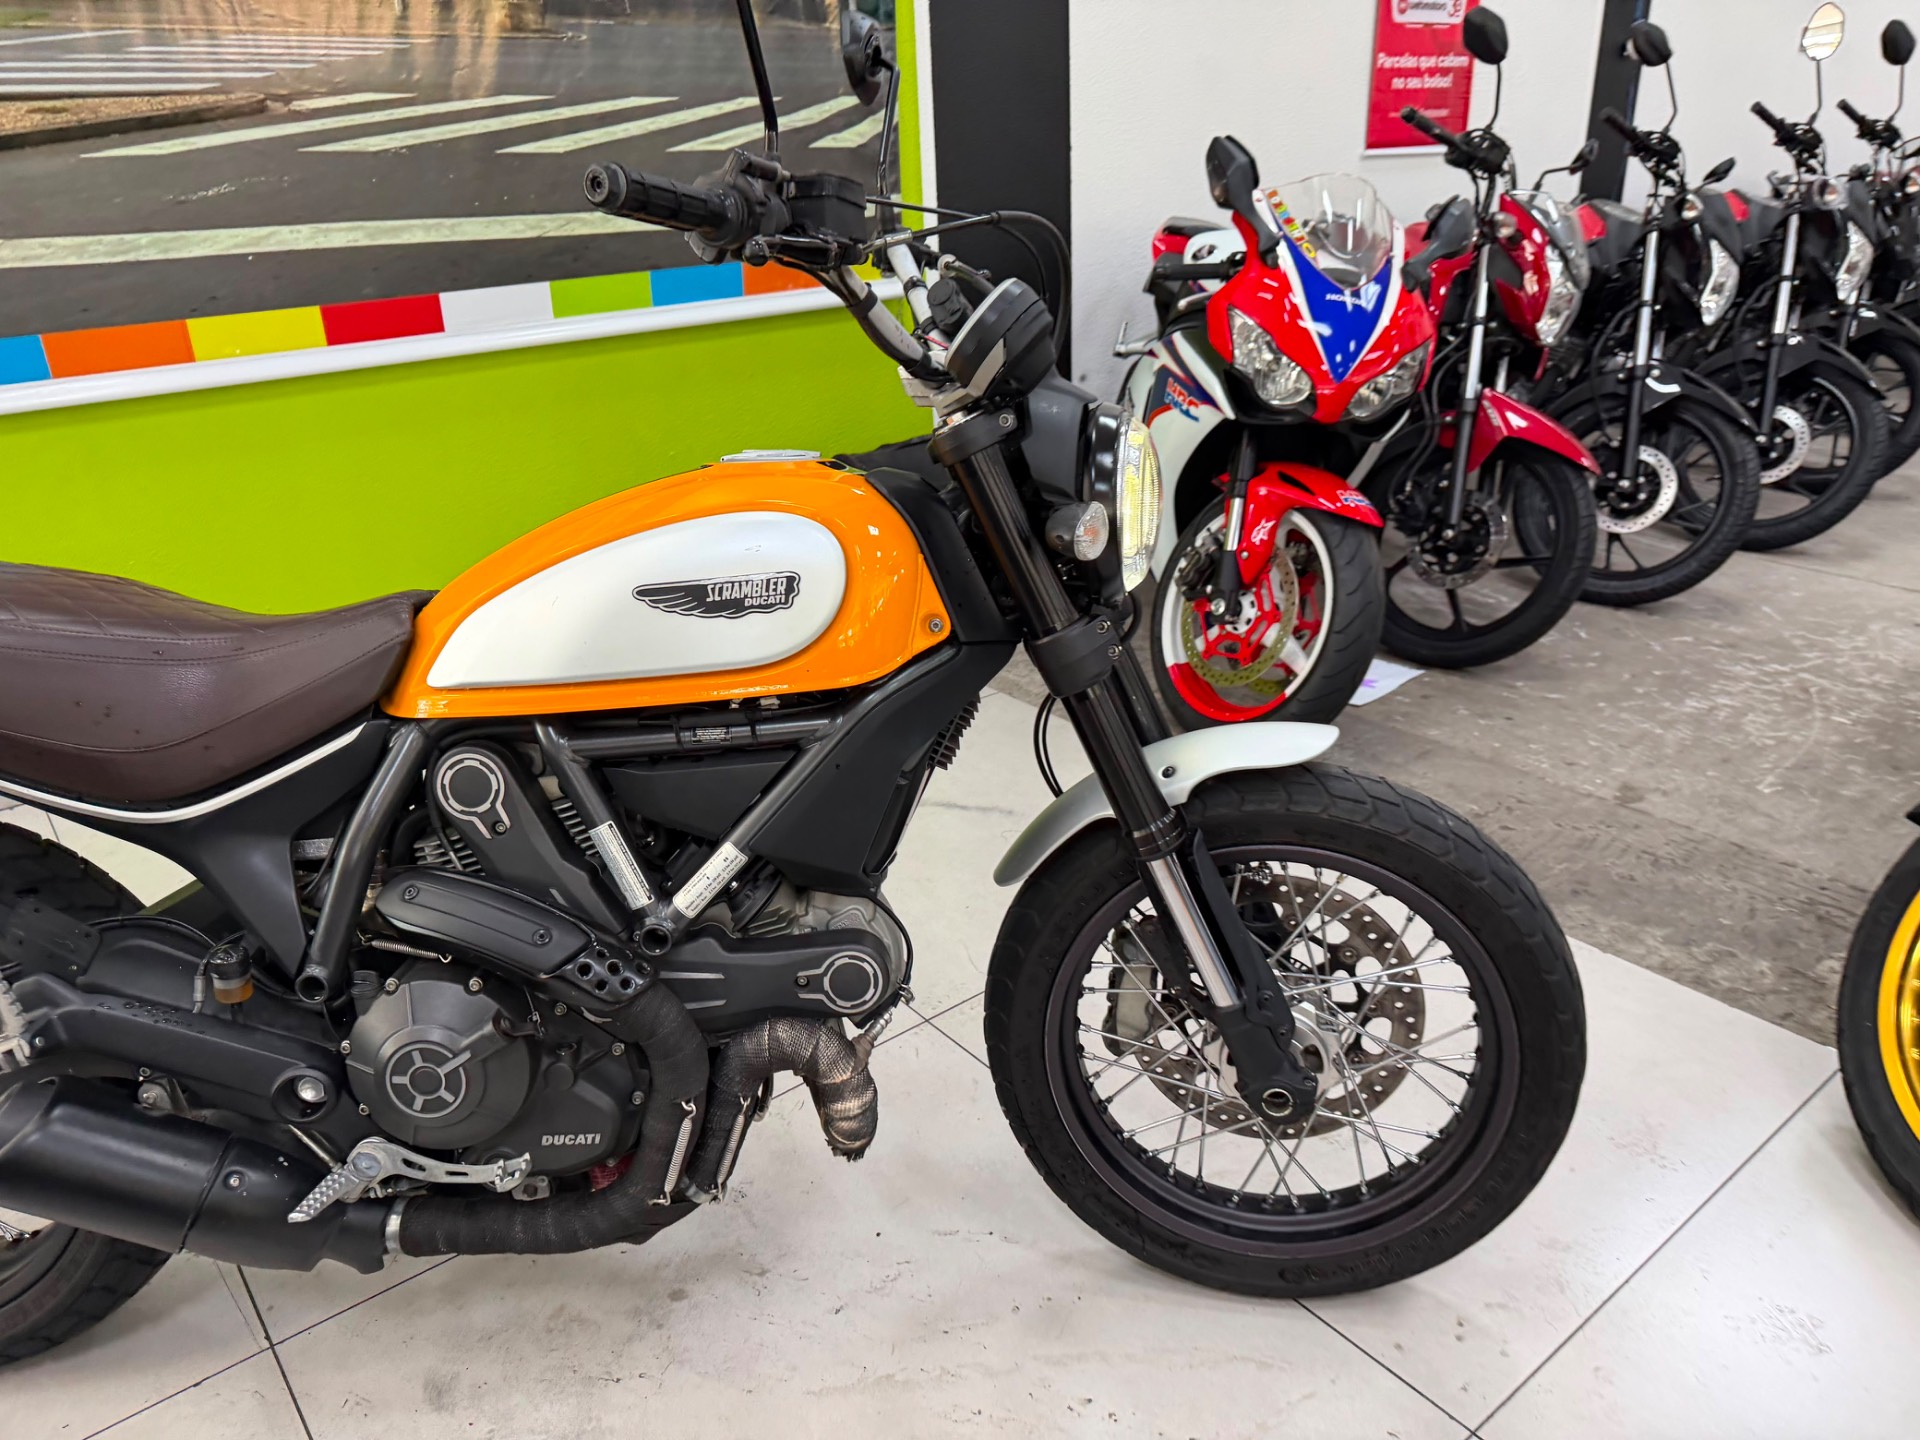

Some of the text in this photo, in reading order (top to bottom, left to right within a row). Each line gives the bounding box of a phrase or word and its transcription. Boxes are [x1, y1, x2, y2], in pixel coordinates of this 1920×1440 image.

[706, 577, 787, 602] SCRAMBLER
[744, 594, 786, 607] DUCATI
[541, 1133, 601, 1146] DUCATI
